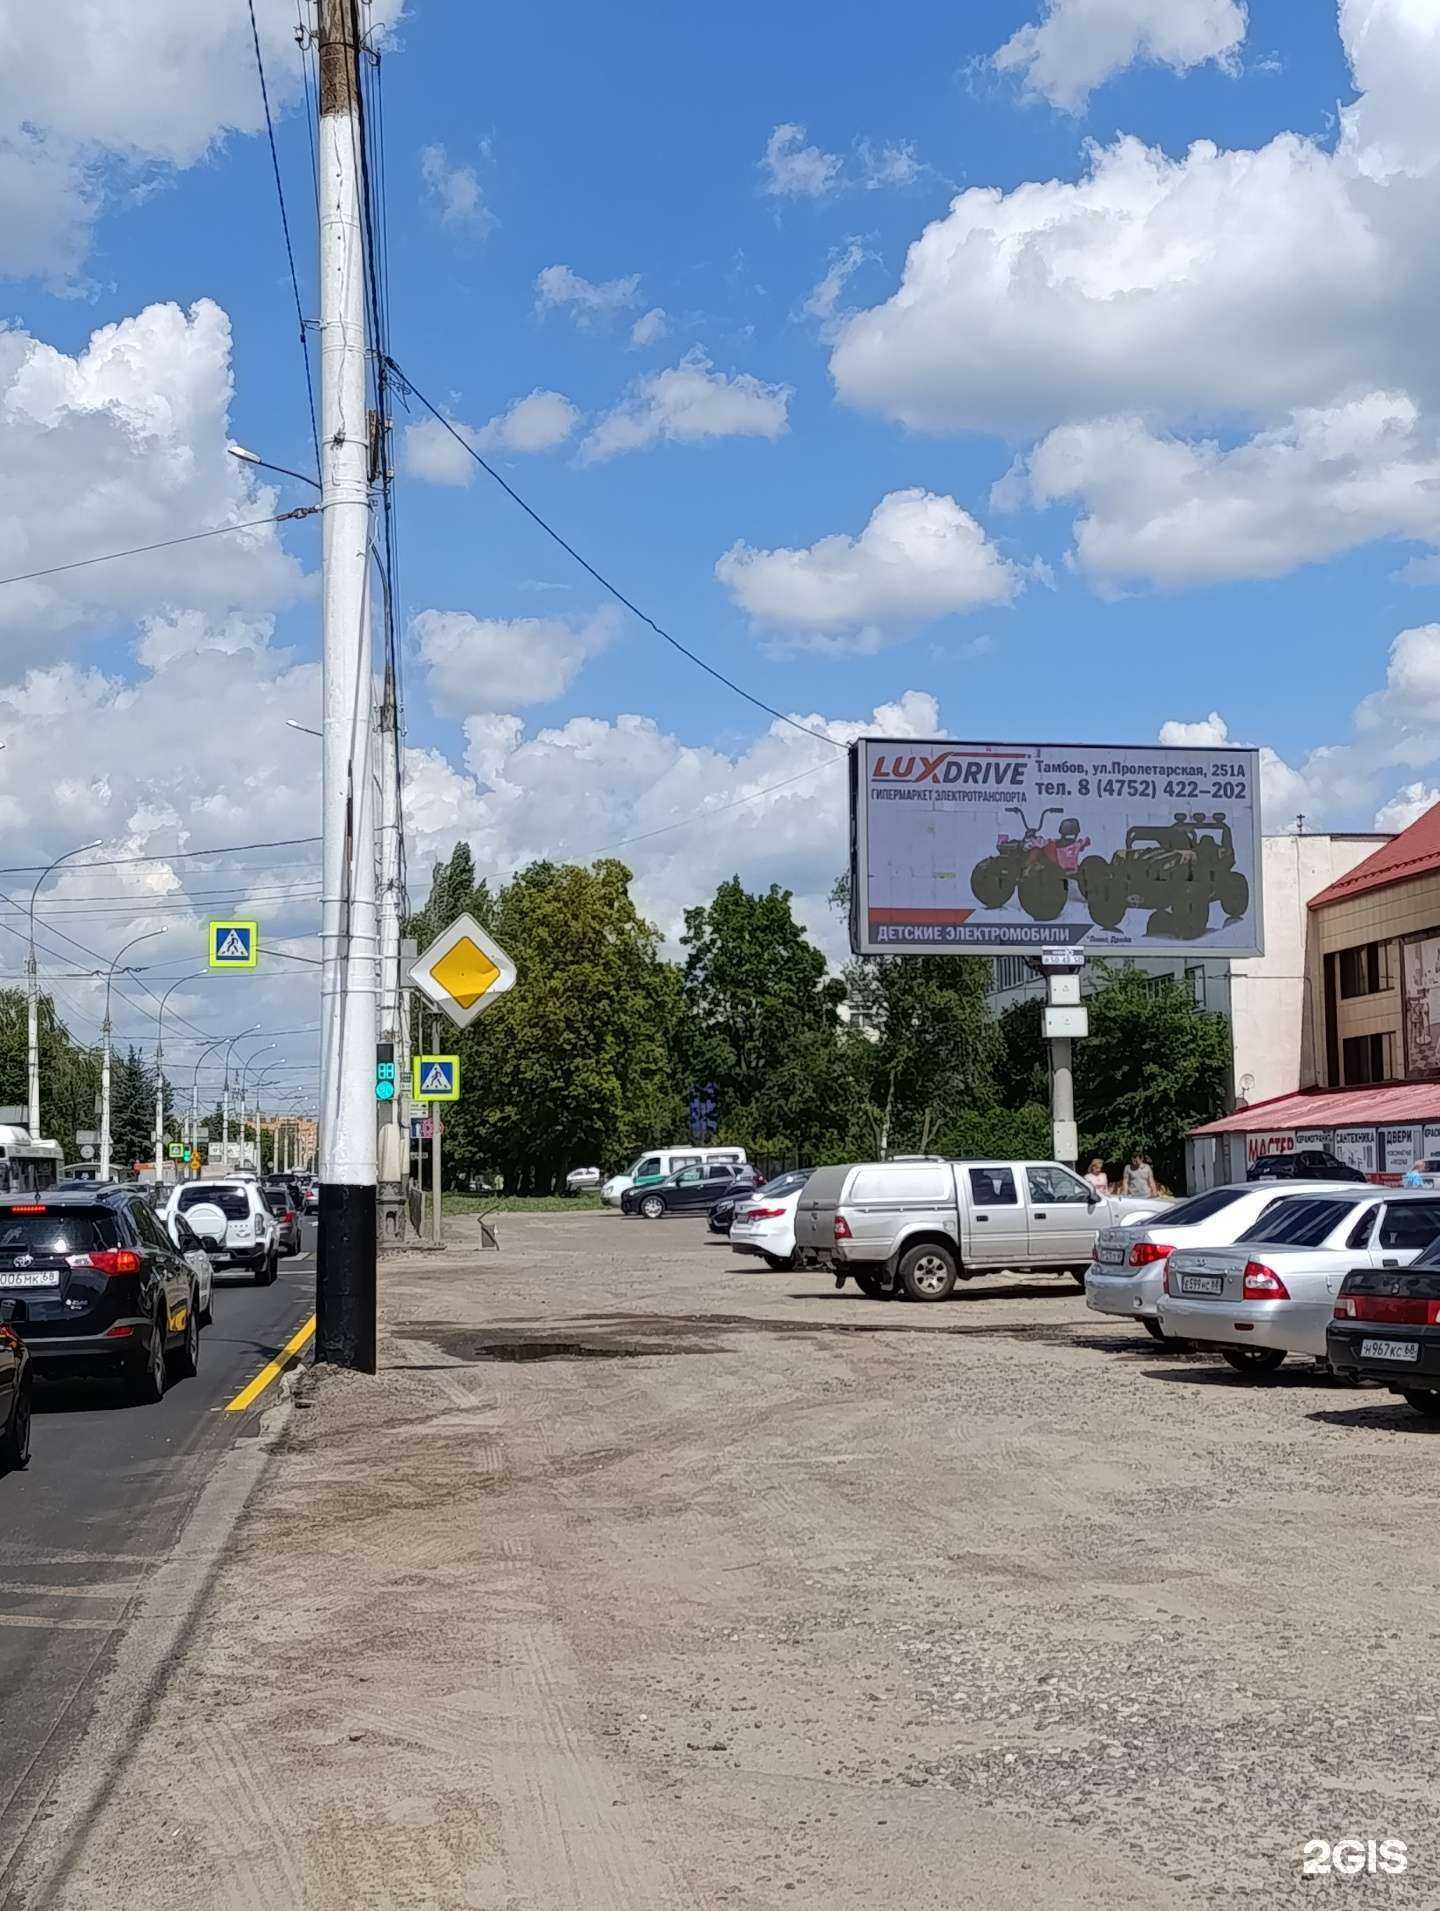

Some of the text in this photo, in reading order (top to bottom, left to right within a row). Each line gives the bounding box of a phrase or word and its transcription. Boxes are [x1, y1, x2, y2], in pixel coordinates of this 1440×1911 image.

[872, 752, 1028, 786] LUXDRIVE
[1035, 760, 1246, 777] Тамбов, ул.Пролетарская, 251А
[871, 788, 1027, 803] ГИПЕРМАРКЕТ ЭЛЕКТРОТРАНСПОРТА
[1035, 779, 1246, 799] тел. 8 (4752) 422-202
[877, 926, 942, 942] ДЕТСКИЕ
[946, 927, 1069, 942] ЭЛЕКТРОМОБИЛИ
[1336, 1132, 1375, 1144] САНТЕХНИКА
[1386, 1129, 1413, 1146] ДВЕРИ
